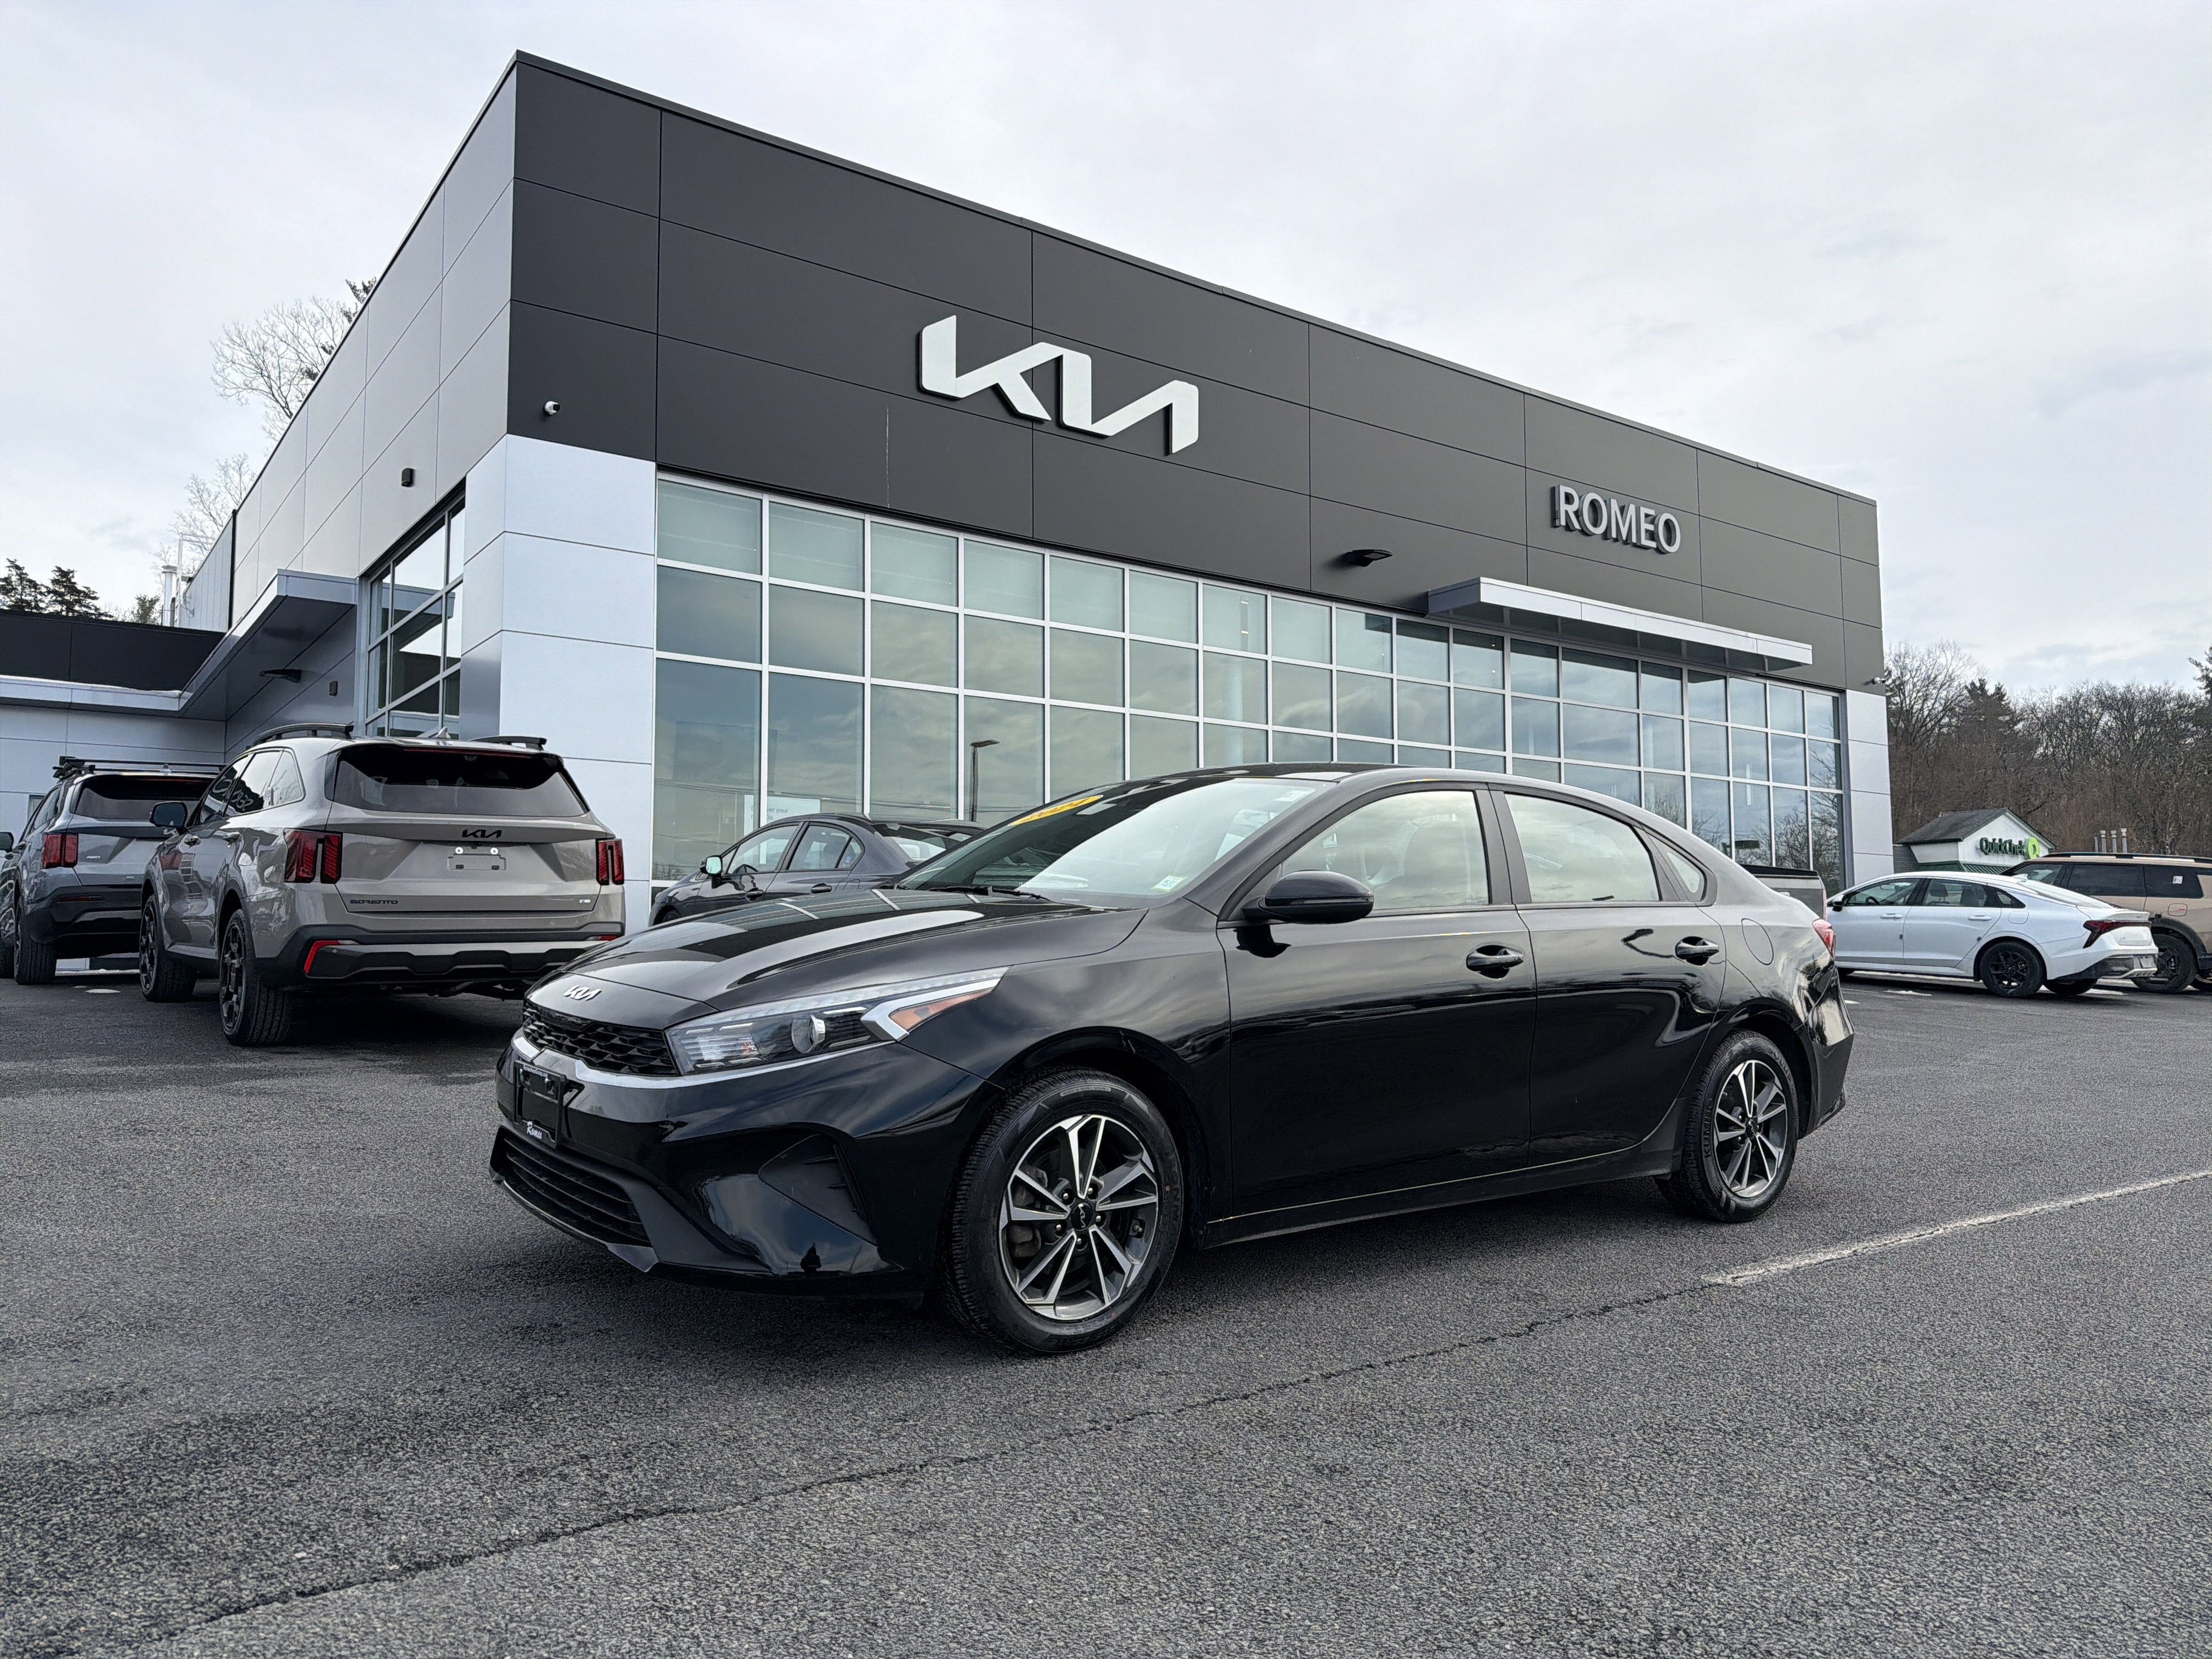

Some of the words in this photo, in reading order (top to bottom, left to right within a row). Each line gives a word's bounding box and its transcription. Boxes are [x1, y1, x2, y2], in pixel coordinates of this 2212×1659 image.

[921, 314, 1199, 454] KIA
[1556, 484, 1681, 554] ROMEO
[1979, 837, 2027, 856] QuickChek
